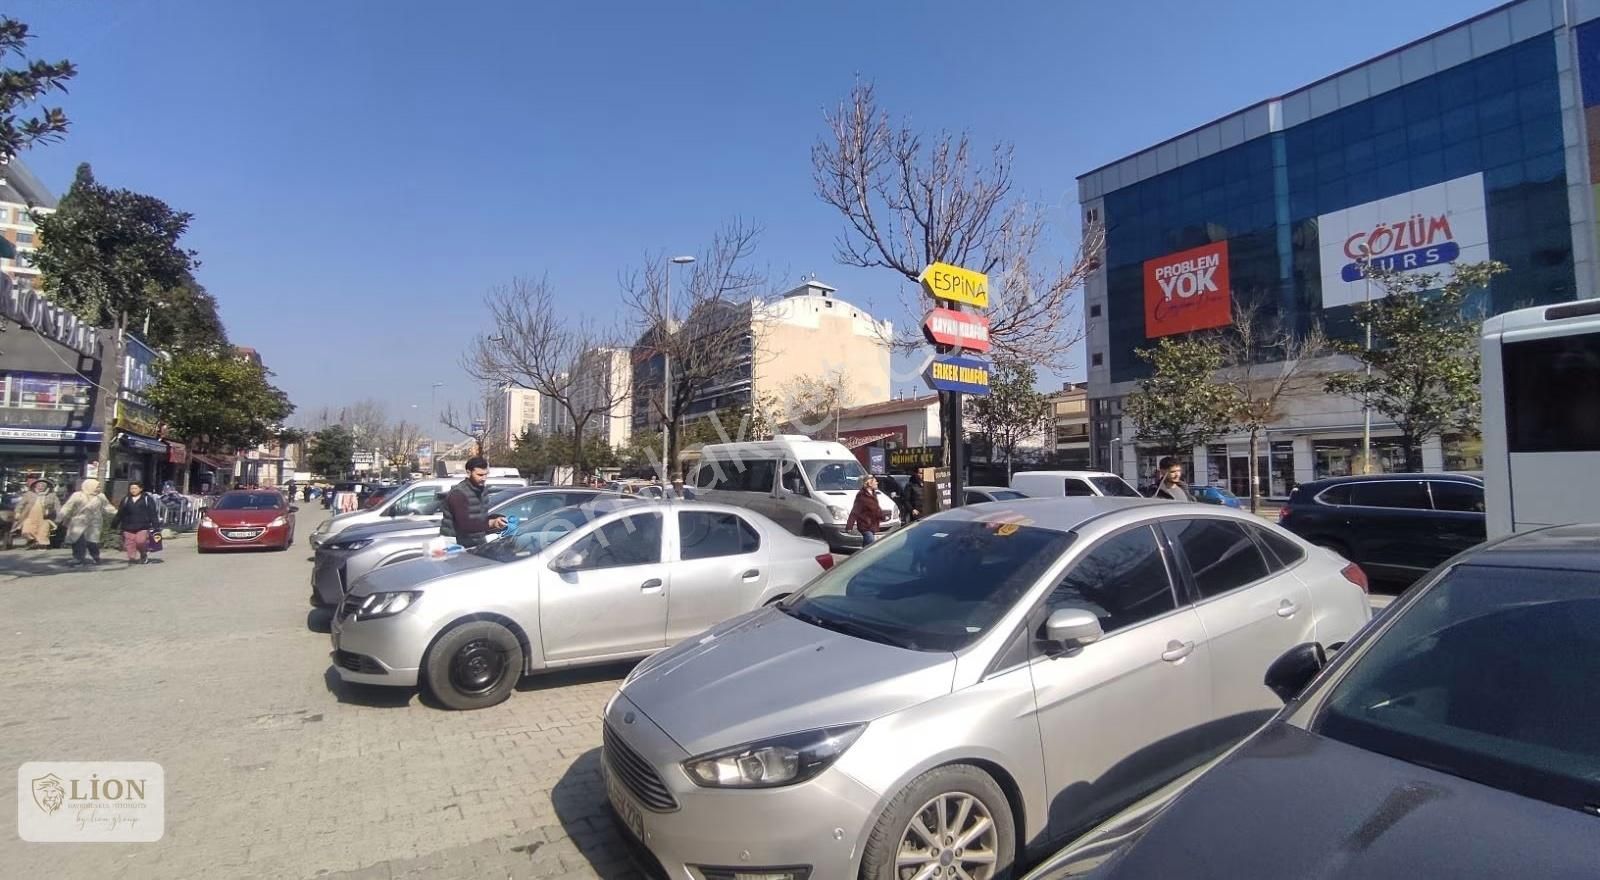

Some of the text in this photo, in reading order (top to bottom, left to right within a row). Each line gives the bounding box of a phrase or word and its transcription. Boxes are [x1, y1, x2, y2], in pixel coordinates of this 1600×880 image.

[1155, 253, 1219, 280] PROBLEM
[1158, 266, 1218, 302] YOK
[933, 362, 958, 381] ERKEK
